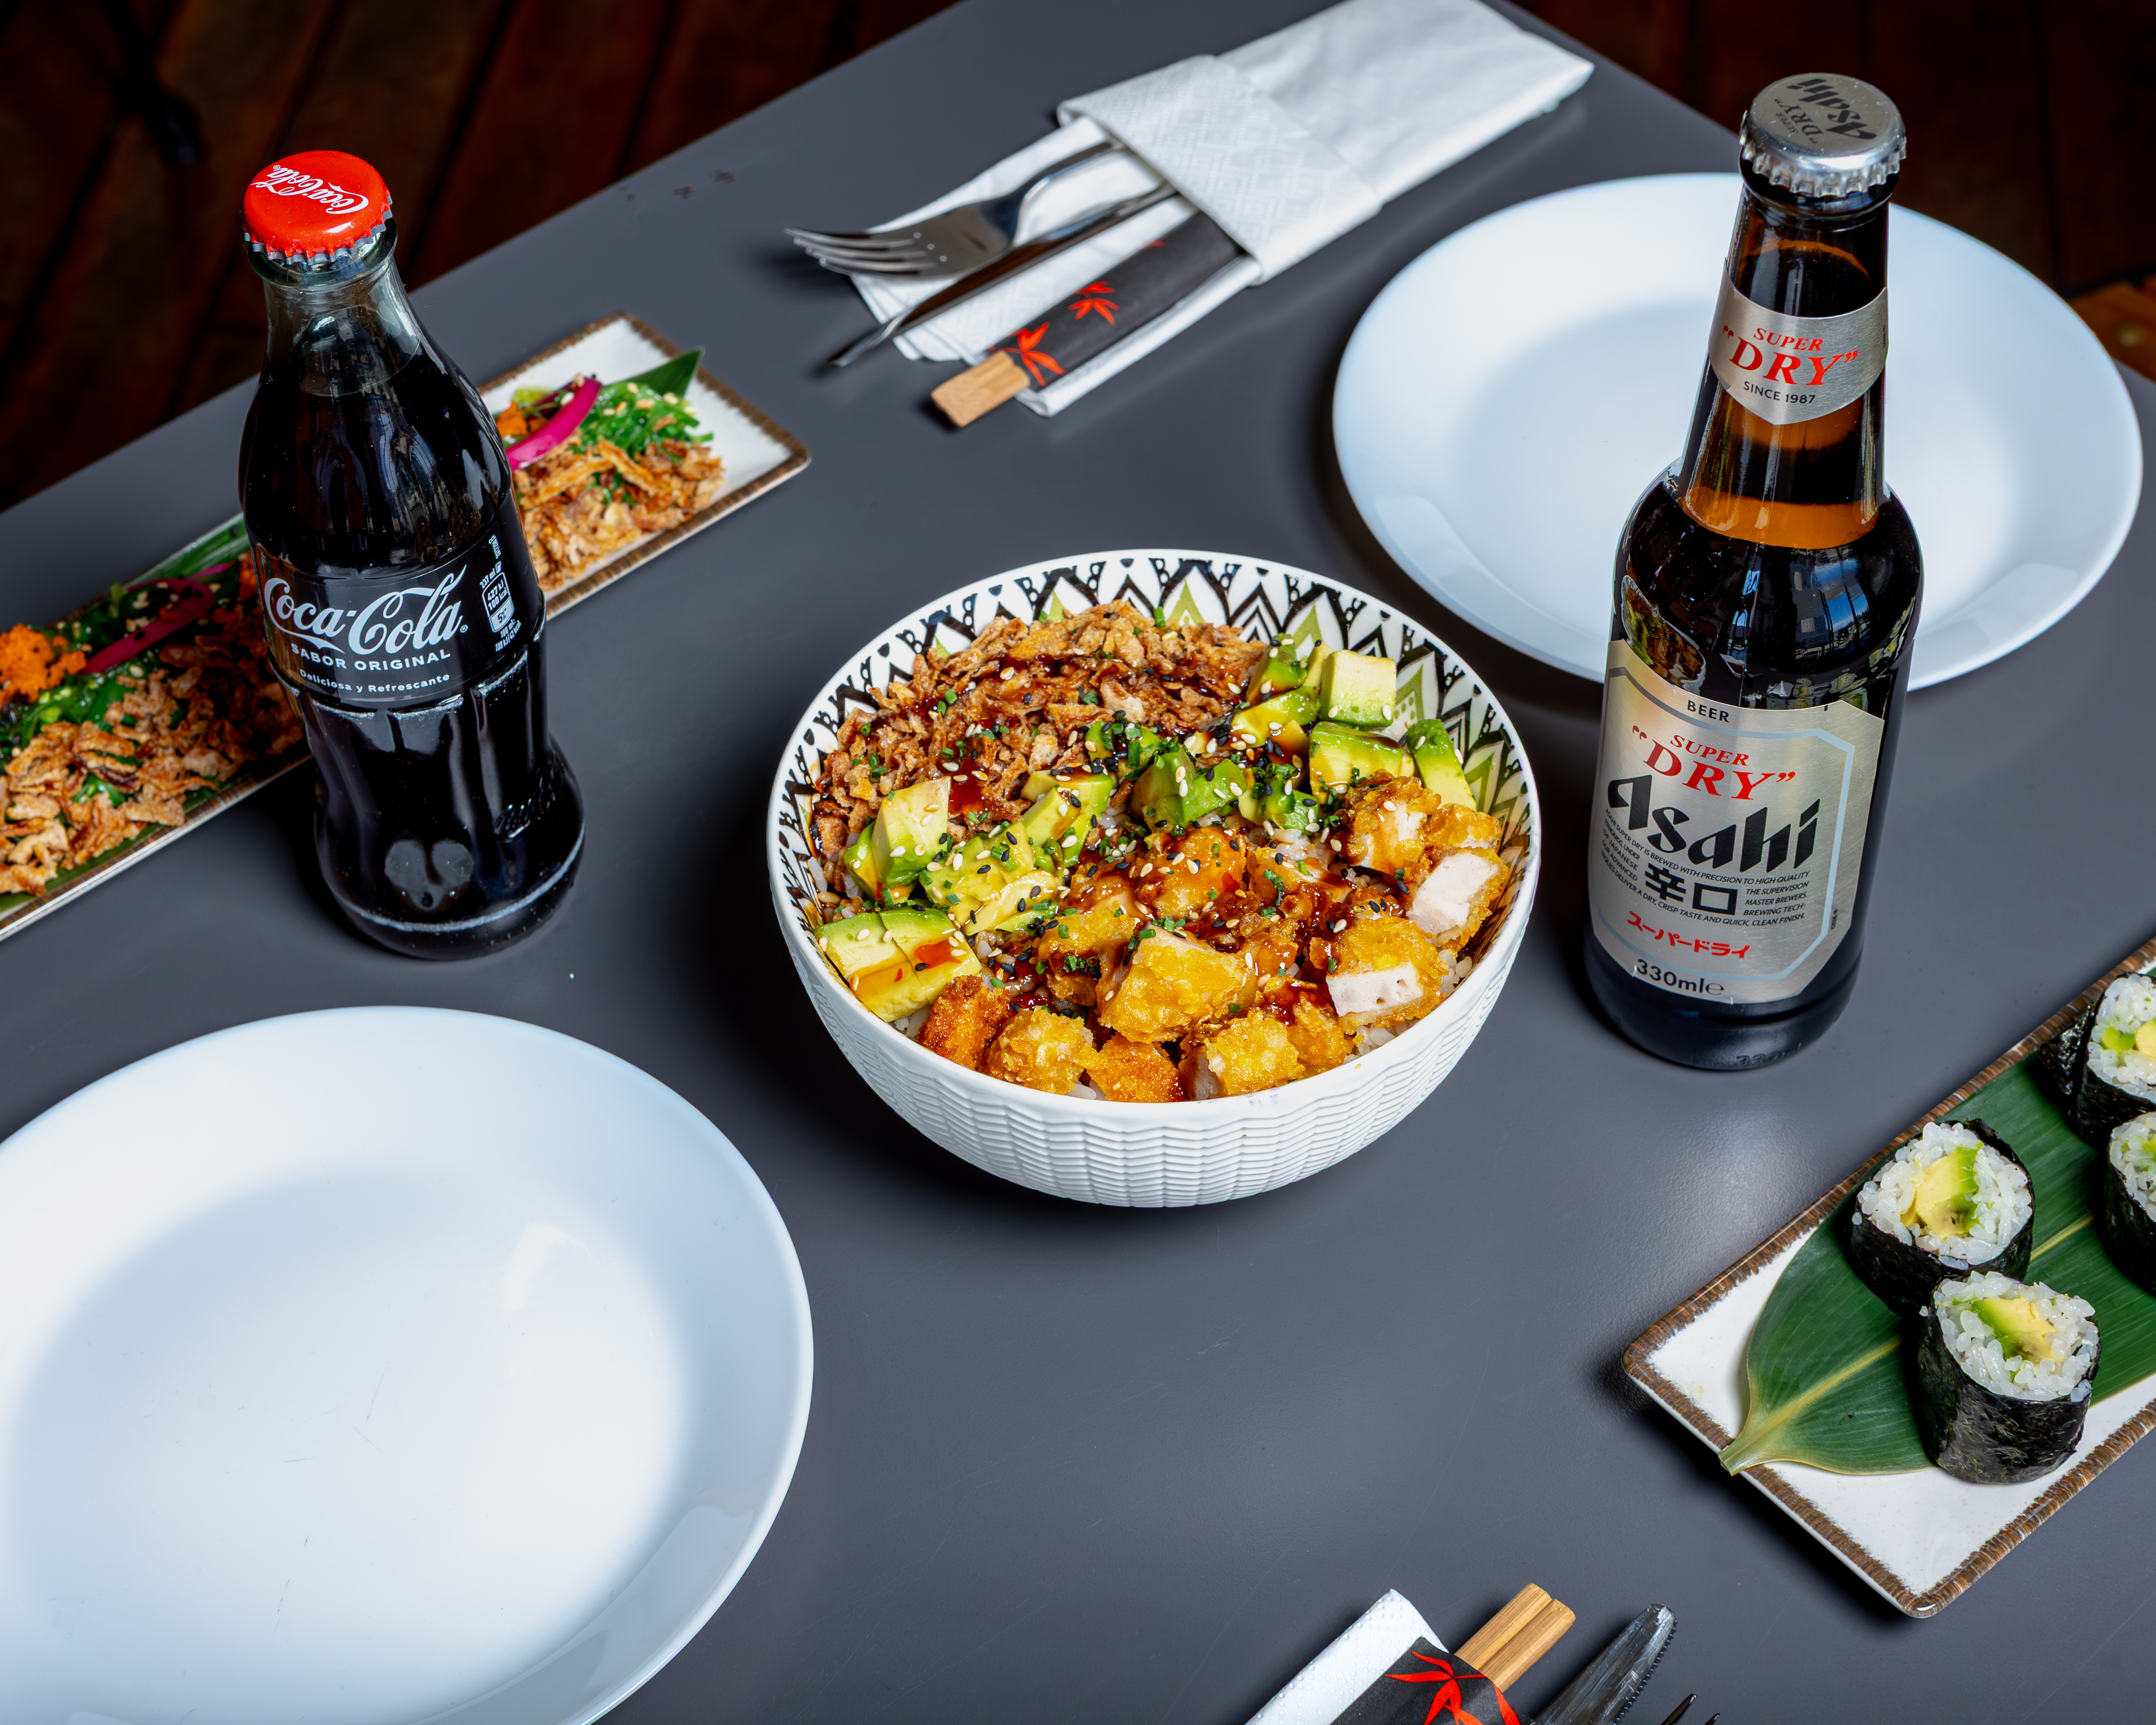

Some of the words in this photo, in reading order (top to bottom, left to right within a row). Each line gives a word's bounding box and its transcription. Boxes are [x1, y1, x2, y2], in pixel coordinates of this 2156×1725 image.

[1786, 78, 1877, 139] Asahi
[250, 167, 369, 214] Coca-Cola
[1753, 327, 1823, 351] SUPER
[1743, 381, 1781, 401] SINCE
[1785, 393, 1816, 404] 1987
[479, 575, 489, 589] 237
[489, 567, 496, 580] ml
[487, 585, 498, 601] 427
[497, 579, 504, 591] kJ
[264, 564, 467, 655] Coca-Cola
[488, 596, 500, 611] 100
[498, 586, 508, 601] kcal
[291, 643, 348, 669] SABOR
[354, 649, 451, 671] ORIGINAL
[300, 669, 353, 691] Deliciosa
[356, 685, 364, 693] y
[368, 674, 450, 693] Refrescante
[1687, 699, 1730, 723] BEER
[1670, 734, 1749, 766] SUPER
[1608, 774, 1820, 873] Asahi
[1609, 840, 1639, 871] JAPANESE
[1616, 824, 1632, 843] SUPER
[1631, 840, 1644, 851] DRY
[1650, 853, 1679, 870] BREWED
[1680, 866, 1701, 877] WITH
[1701, 871, 1743, 884] PRECISION
[1777, 871, 1811, 883] QUALITY
[1623, 844, 1641, 861] UNDER
[1761, 881, 1809, 895] SUPERVISION
[1609, 853, 1638, 881] ADVANCED
[1743, 907, 1782, 916] BREWING
[1615, 869, 1637, 893] DELIVER
[1658, 901, 1679, 914] CRISP
[1679, 909, 1703, 920] TASTE
[1703, 915, 1722, 924] AND
[1722, 918, 1750, 927] QUICK,
[1752, 917, 1779, 926] CLEAN
[1644, 862, 1739, 916] 辛口
[1627, 910, 1750, 958] スーパードライ
